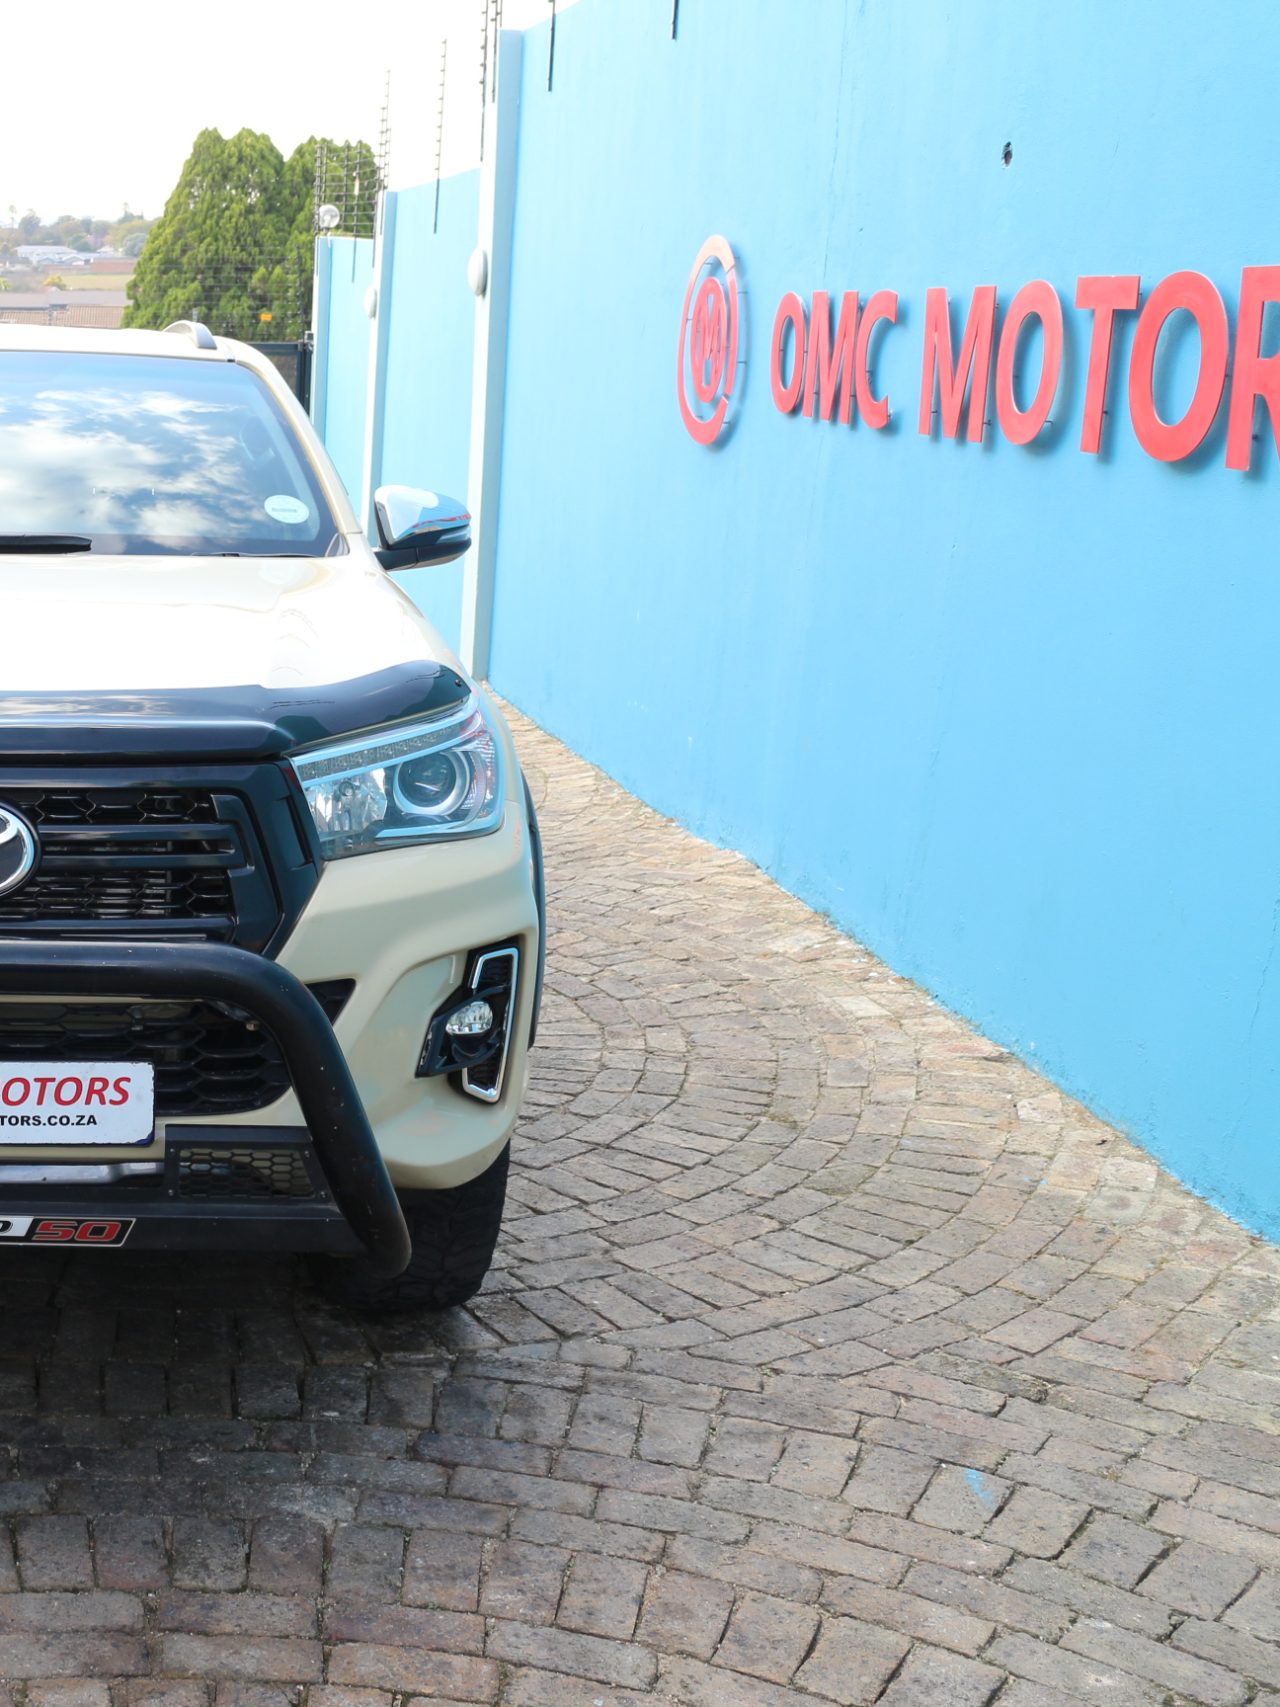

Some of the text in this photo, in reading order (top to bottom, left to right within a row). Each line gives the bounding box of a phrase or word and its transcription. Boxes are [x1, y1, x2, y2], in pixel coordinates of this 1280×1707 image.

[771, 265, 1280, 471] OMC MOTOR
[31, 1219, 122, 1242] 50
